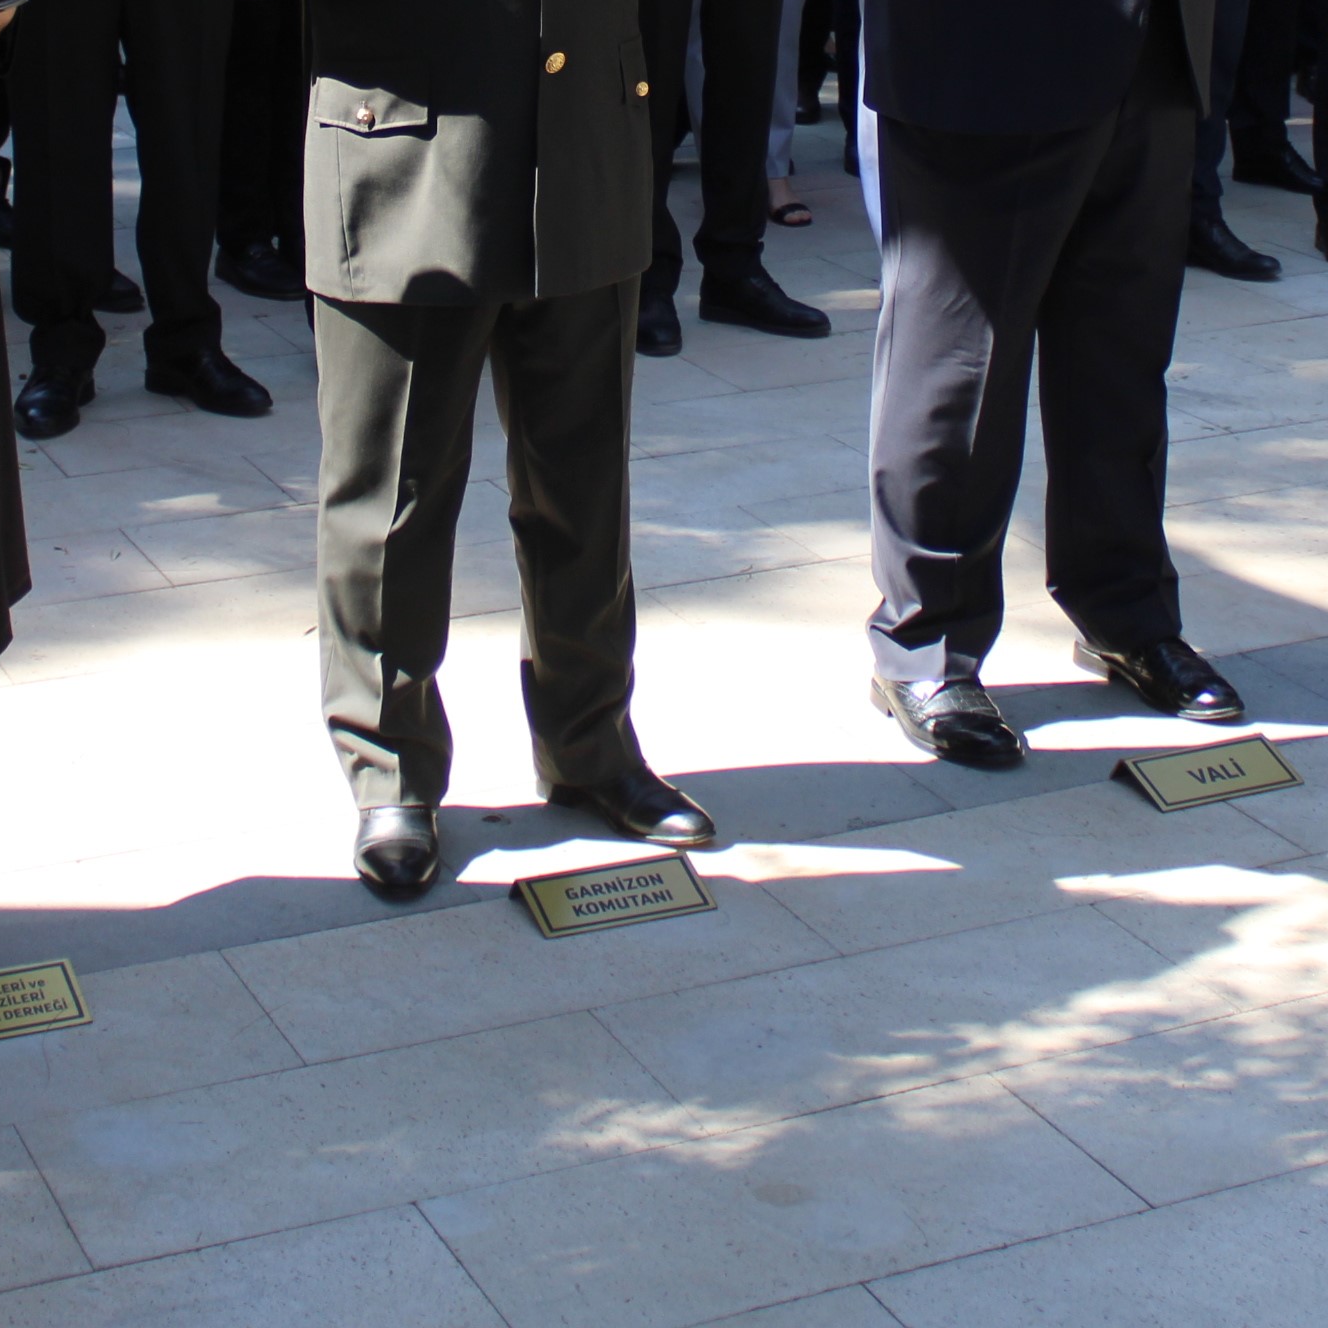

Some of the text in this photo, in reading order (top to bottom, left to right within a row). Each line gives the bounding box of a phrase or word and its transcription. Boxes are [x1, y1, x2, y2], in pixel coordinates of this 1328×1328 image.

[1187, 757, 1246, 784] VALİ
[565, 873, 664, 900] GARNİZON
[572, 889, 674, 917] KOMUTANI
[28, 979, 46, 989] ve
[3, 997, 68, 1021] DERNEĞİ
